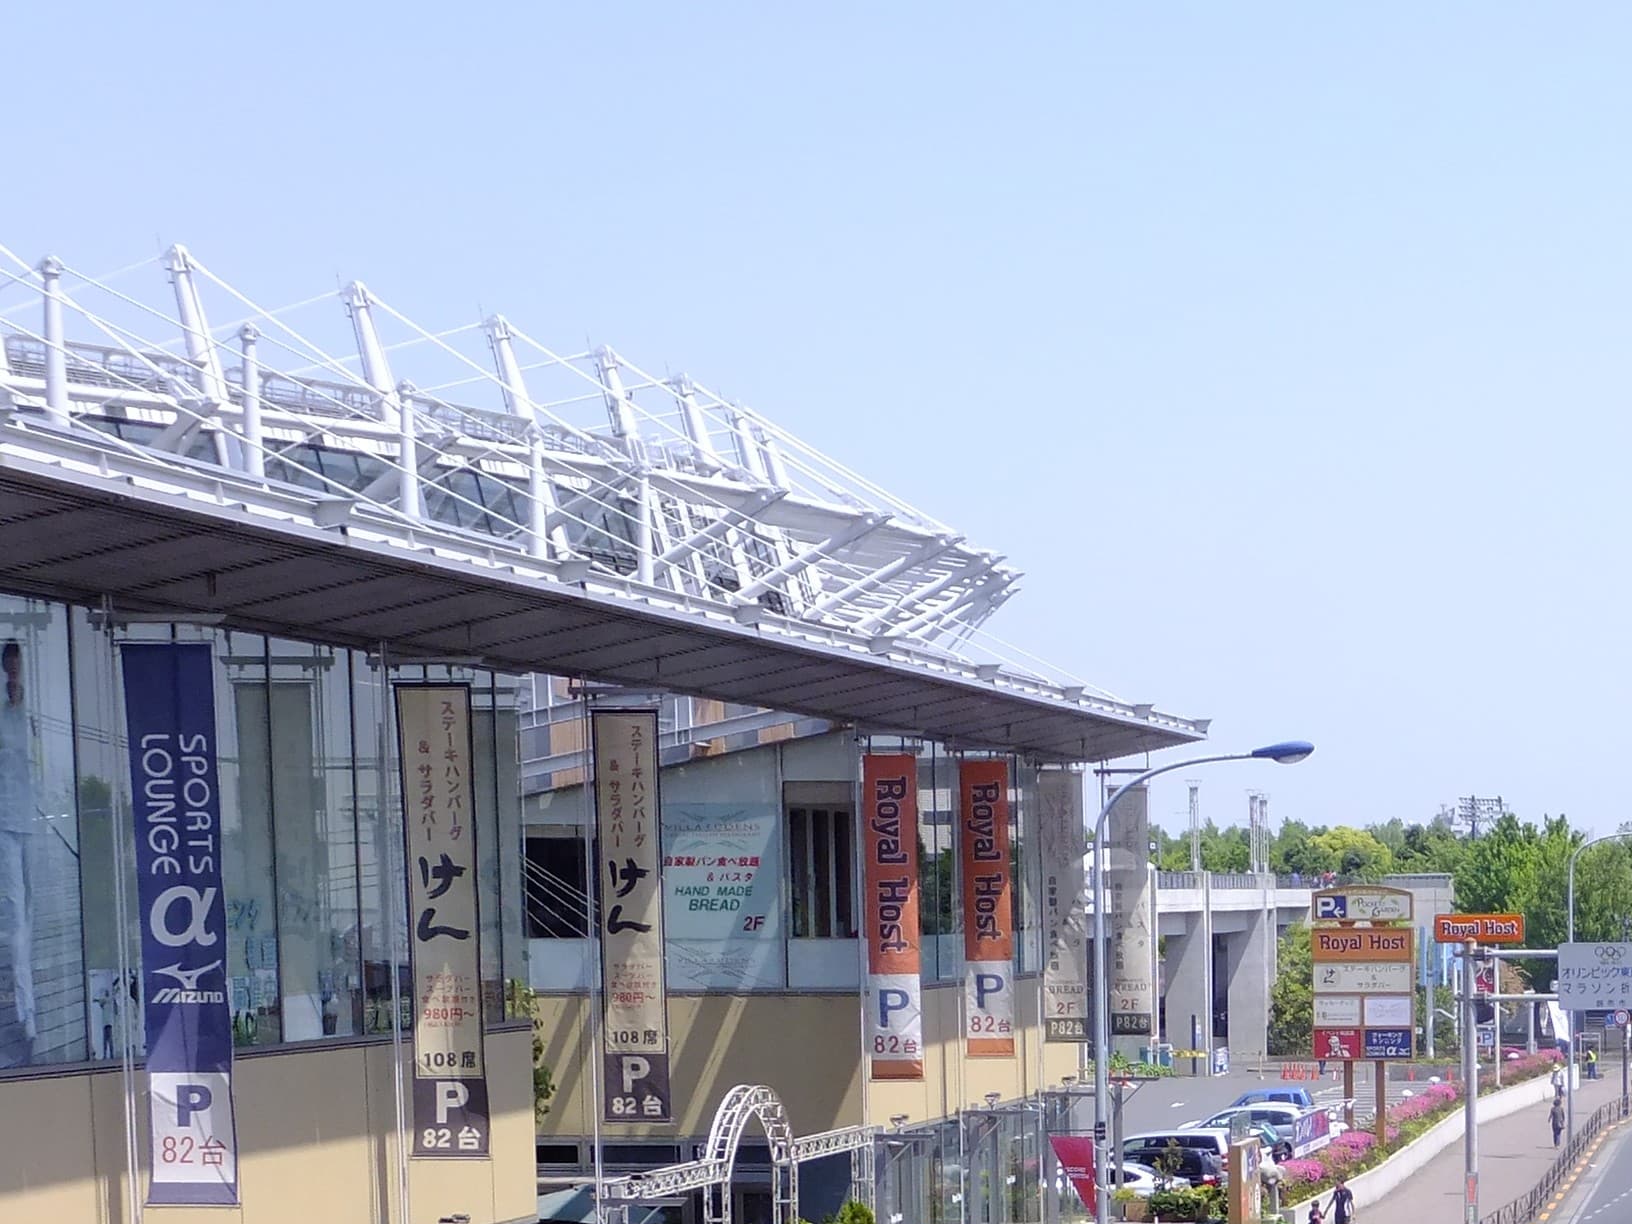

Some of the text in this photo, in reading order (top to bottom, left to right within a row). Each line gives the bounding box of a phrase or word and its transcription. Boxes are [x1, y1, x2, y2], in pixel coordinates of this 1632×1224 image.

[141, 733, 181, 876] LOUNGE
[179, 733, 214, 874] SPORTS
[871, 775, 911, 956] Royal Host
[965, 780, 1004, 944] Royal Host
[417, 852, 472, 943] けん
[607, 857, 652, 935] けん
[674, 885, 753, 896] HAND MADE
[688, 899, 741, 911] BREAD
[1317, 897, 1336, 918] P
[743, 916, 766, 932] 2F
[1440, 920, 1519, 937] Royal Host
[1318, 934, 1406, 953] Royal Host
[976, 973, 1005, 1010] P
[1121, 998, 1140, 1010] 2F
[878, 988, 911, 1029] P
[1056, 1002, 1076, 1015] 2F
[970, 1015, 1011, 1033] 82台
[873, 1035, 918, 1054] 82台
[622, 1056, 651, 1094] P
[176, 1084, 213, 1128] P
[435, 1081, 470, 1124] P
[611, 1095, 663, 1116] 82台
[161, 1135, 228, 1168] 82台
[422, 1125, 481, 1150] 82台
